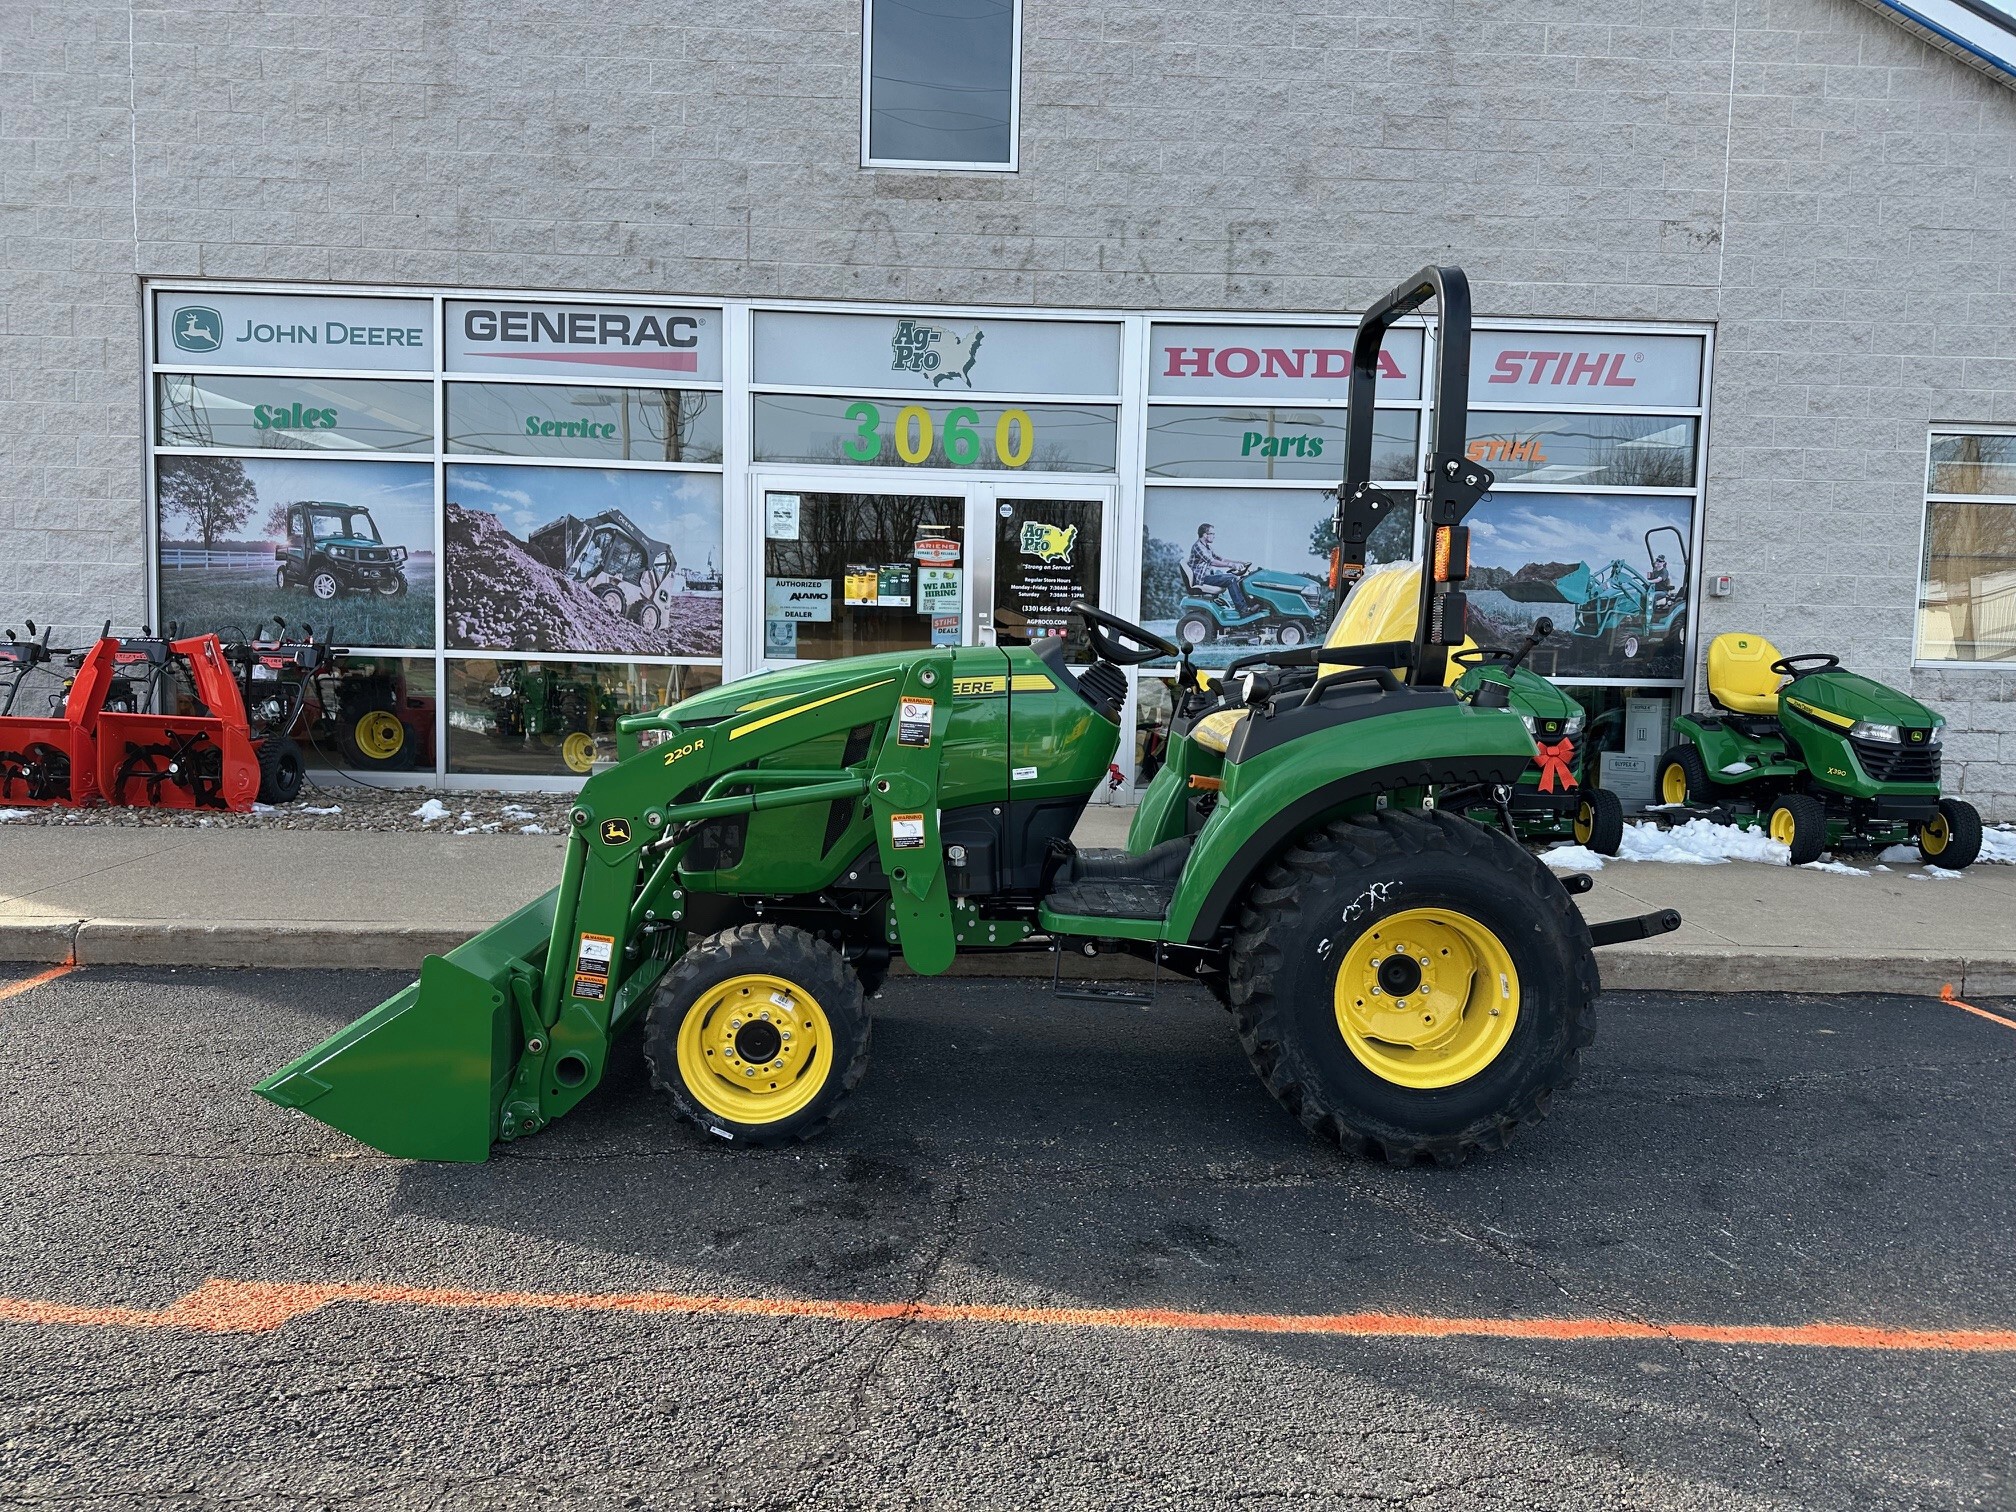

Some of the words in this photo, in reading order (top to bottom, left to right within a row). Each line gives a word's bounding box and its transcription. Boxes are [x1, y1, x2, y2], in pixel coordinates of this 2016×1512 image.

[236, 319, 317, 344] JOHN
[325, 321, 424, 347] DEERE
[464, 309, 698, 348] GENERAC
[893, 345, 941, 370] Pro
[1488, 350, 1636, 386] STIHL
[253, 402, 338, 430] Sales
[525, 416, 616, 439] Service
[842, 401, 1034, 467] 3060
[1241, 431, 1324, 458] Parts
[1465, 440, 1548, 462] STIHL
[1023, 523, 1050, 540] Ag-
[1023, 537, 1050, 551] Pro
[789, 592, 828, 601] ALAMO
[924, 590, 956, 598] HIRING
[940, 582, 958, 590] ARE
[934, 617, 958, 627] STIHL
[664, 744, 693, 766] 220
[694, 738, 704, 751] R
[1826, 766, 1847, 777] X390
